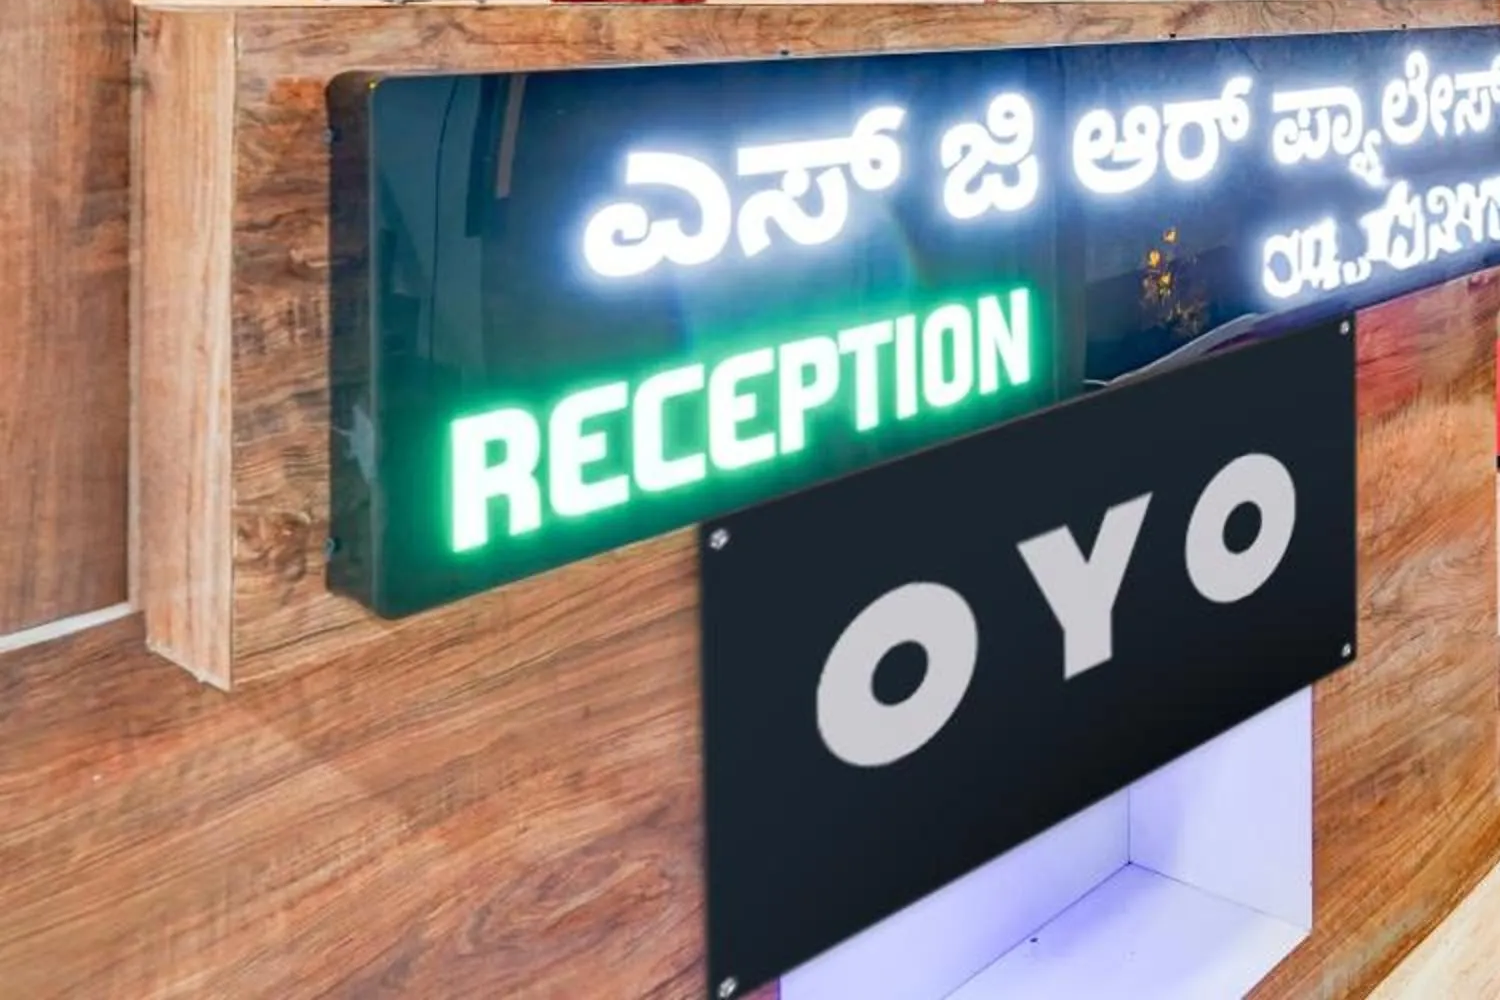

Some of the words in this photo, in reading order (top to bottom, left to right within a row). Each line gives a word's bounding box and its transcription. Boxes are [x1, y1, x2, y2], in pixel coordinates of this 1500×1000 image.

[583, 105, 906, 278] ಎಸ್
[940, 92, 1039, 219] ಜಿ
[1072, 76, 1253, 194] ಆರ್
[450, 287, 1031, 555] RECEPTION
[816, 452, 1297, 768] OYO
